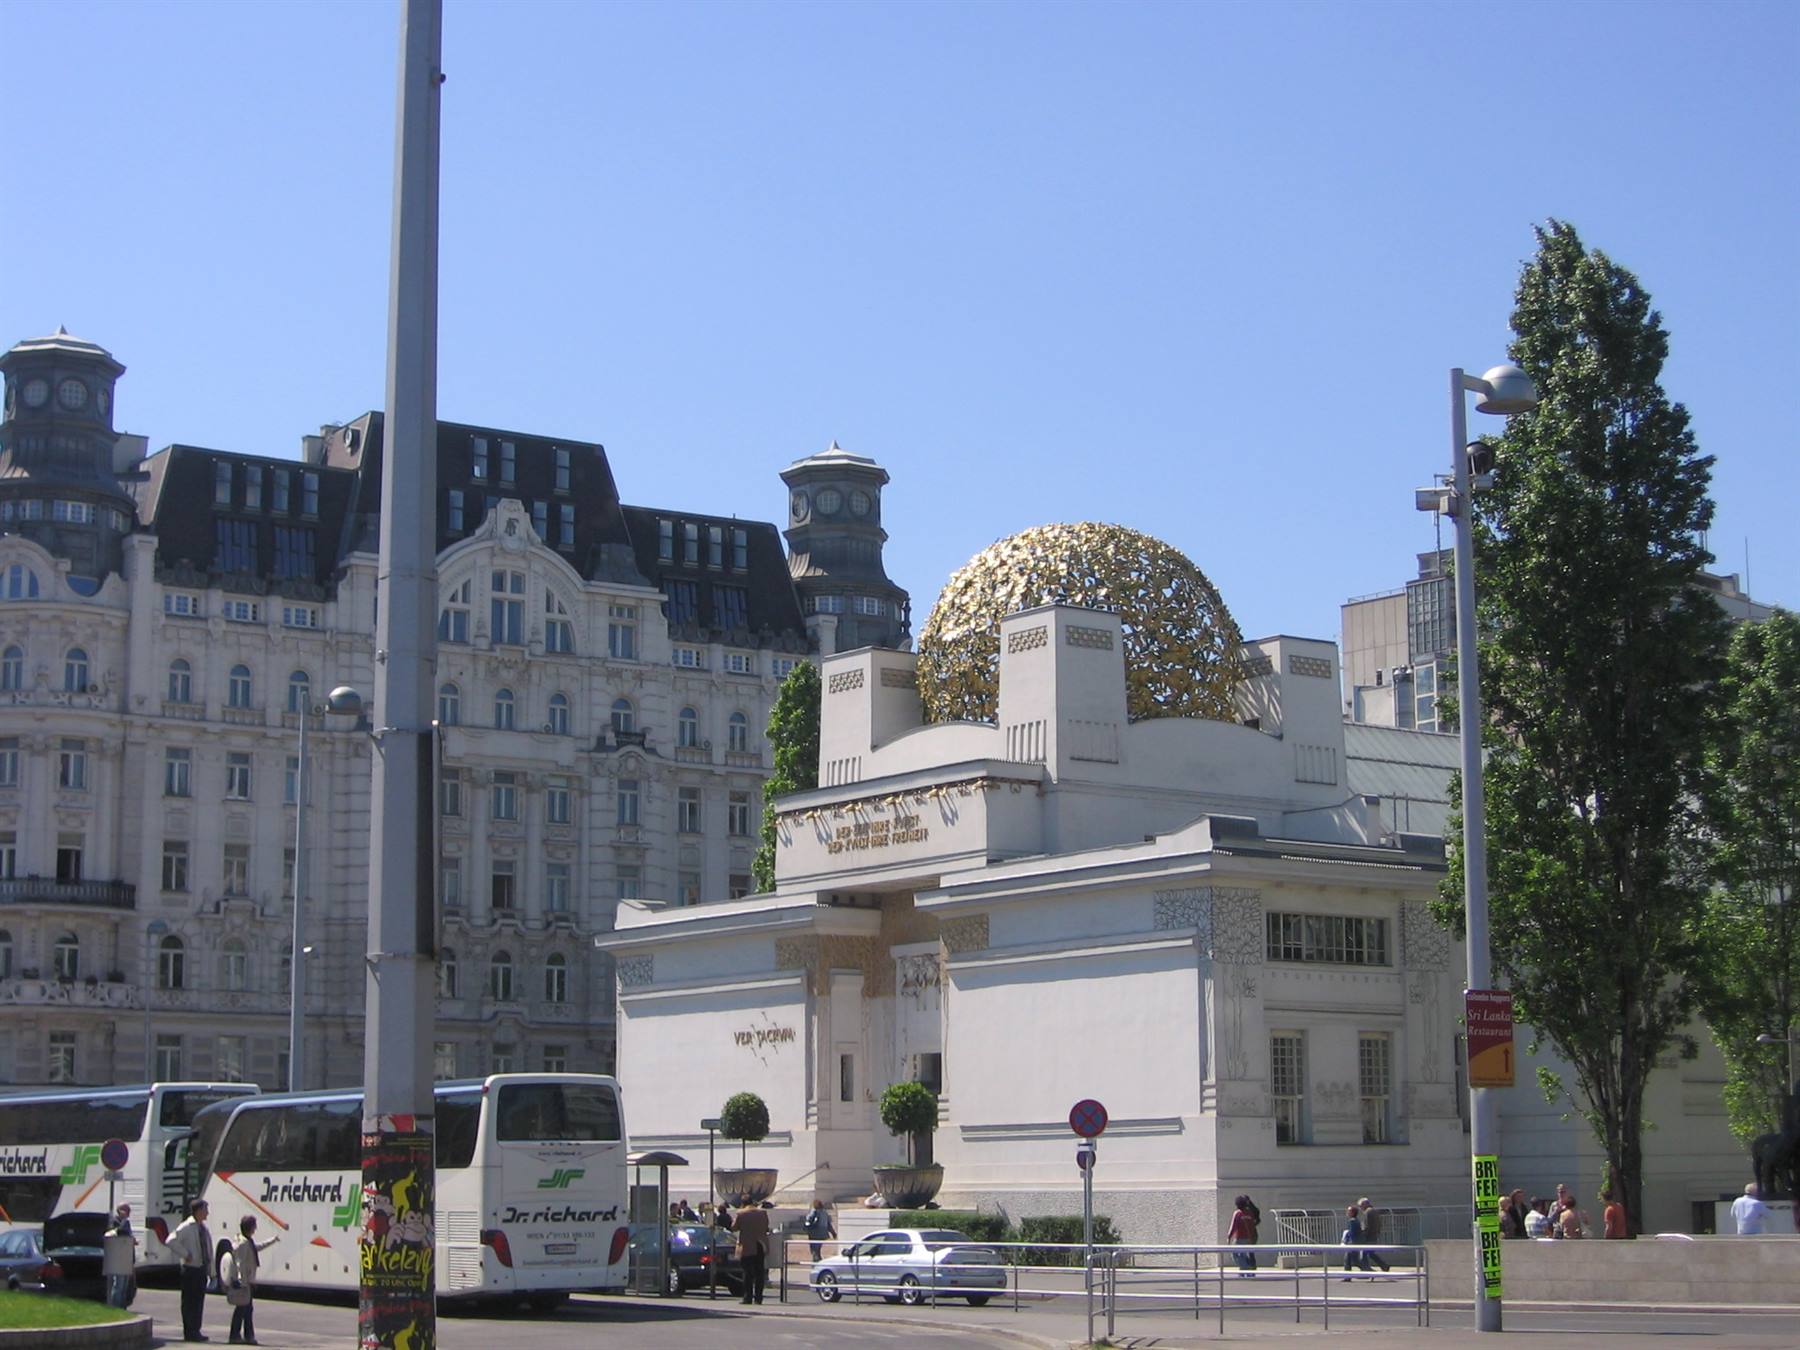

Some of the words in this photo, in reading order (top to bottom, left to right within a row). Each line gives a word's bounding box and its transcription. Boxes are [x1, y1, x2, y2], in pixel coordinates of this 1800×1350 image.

[1467, 1009, 1481, 1021] Sri
[1483, 1008, 1511, 1022] Lanka
[1467, 1025, 1512, 1037] Restaurant
[260, 1176, 279, 1202] Dr.
[280, 1175, 343, 1202] richard
[502, 1207, 529, 1223] Dr.
[532, 1205, 618, 1222] richard
